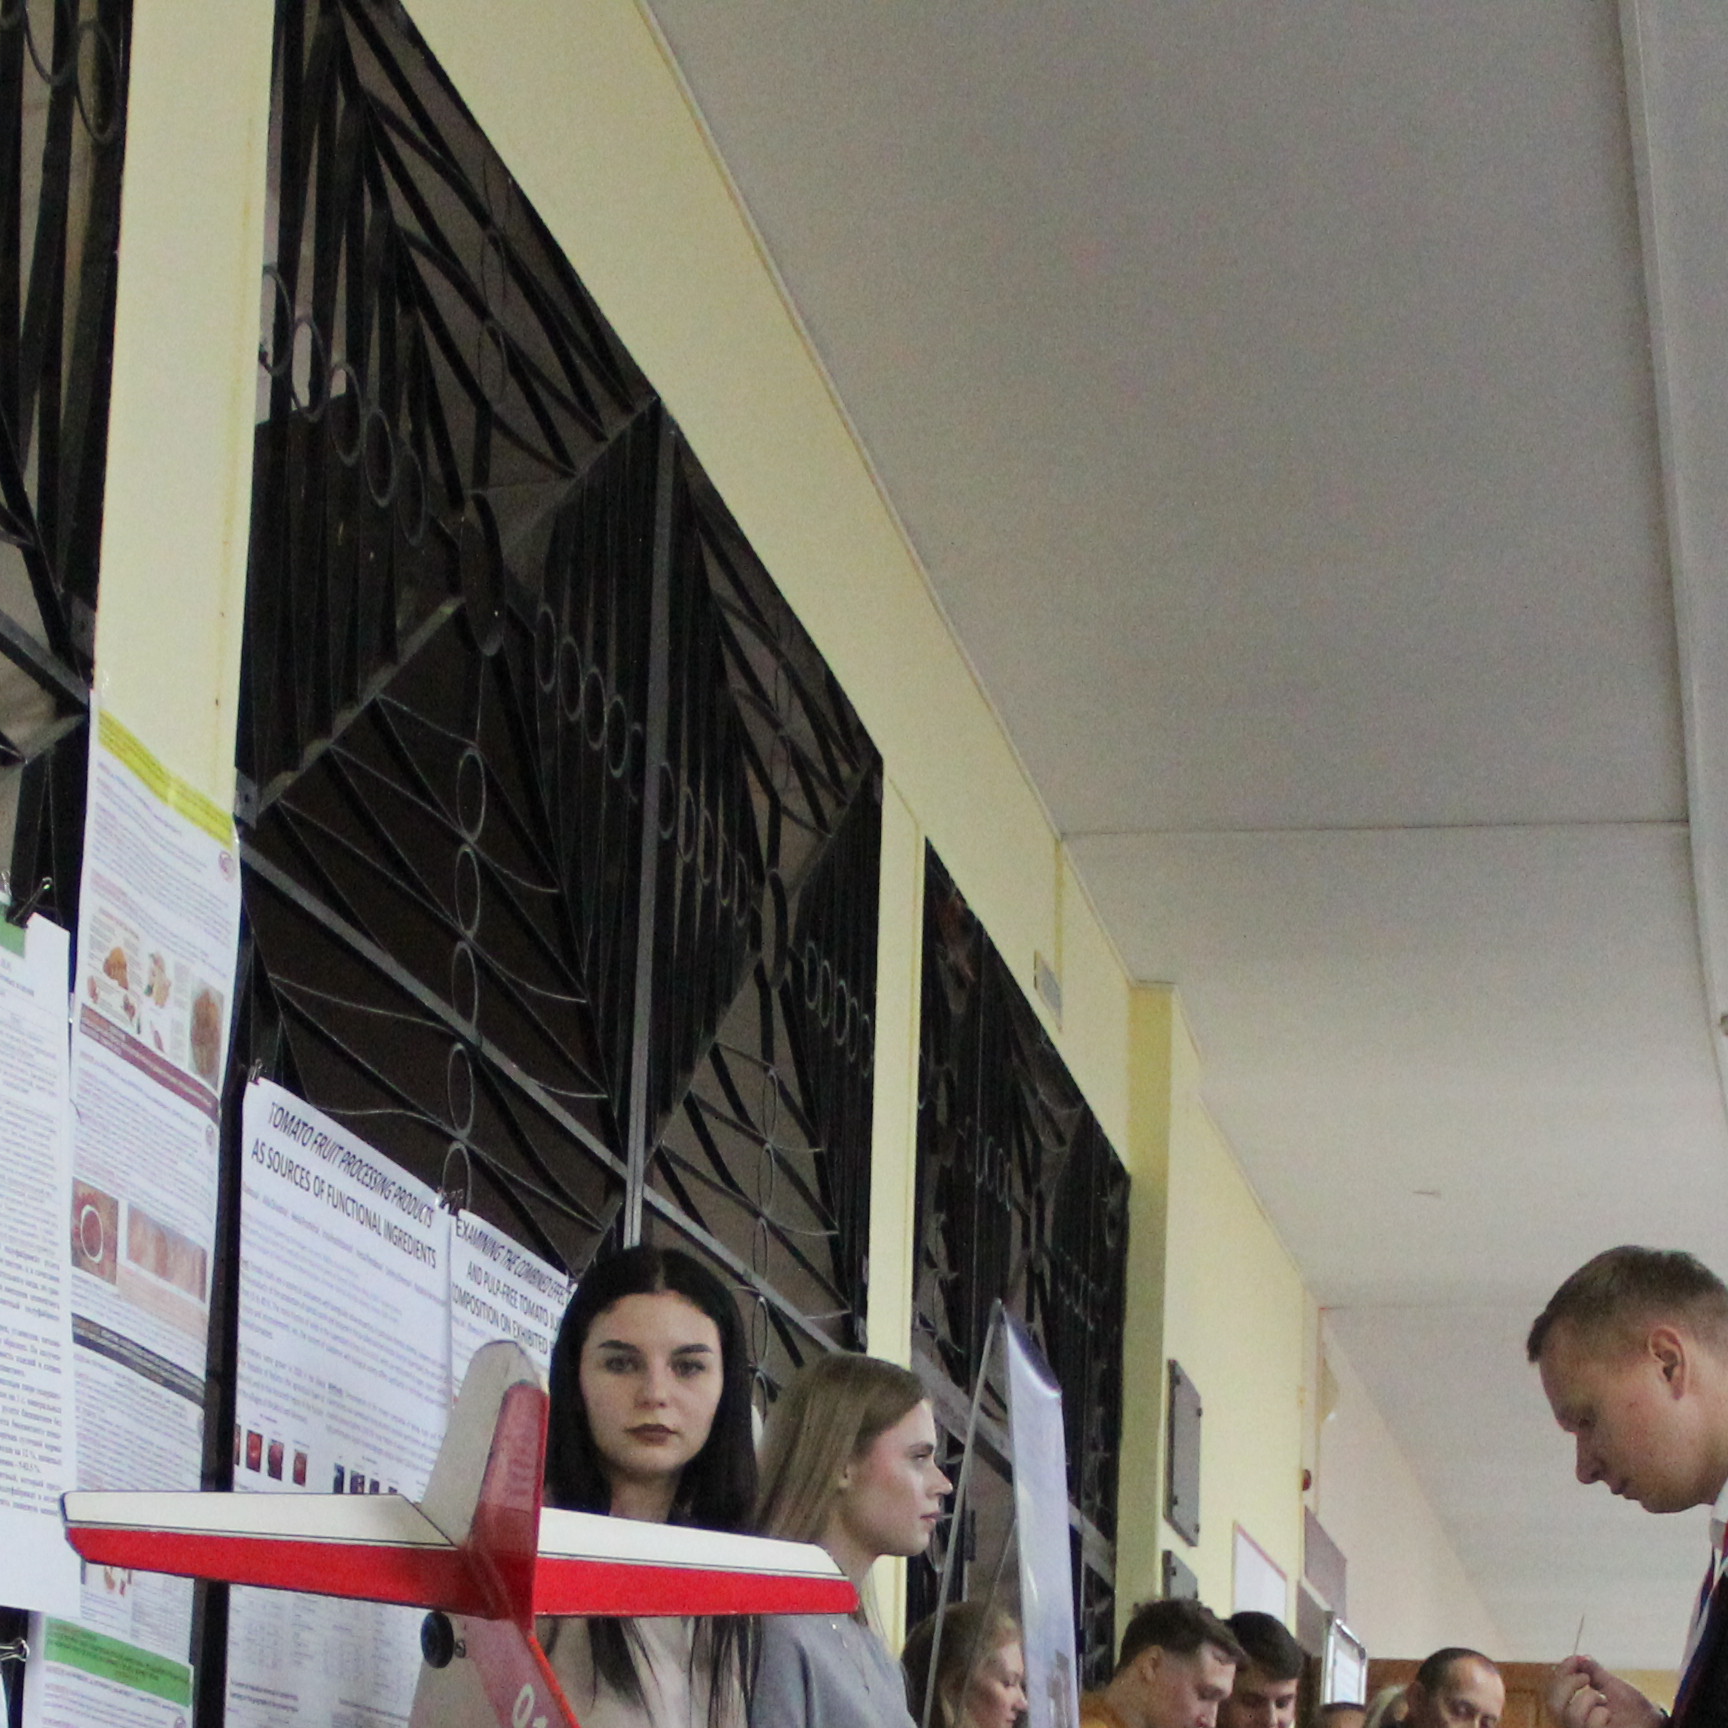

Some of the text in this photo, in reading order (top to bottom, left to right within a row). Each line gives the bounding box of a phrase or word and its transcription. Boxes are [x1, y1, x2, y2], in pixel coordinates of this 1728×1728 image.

[268, 1102, 434, 1229] TOMATO FRUIT PROCESSING PRODUCTS
[251, 1138, 437, 1269] AS SOURCES OF FUNCTIONAL INGREDIENTS
[455, 1216, 502, 1266] EXAMINING
[500, 1247, 521, 1272] THE
[466, 1261, 485, 1287] AND
[483, 1267, 520, 1310] PULP-FREE
[519, 1294, 549, 1328] TOMATO
[500, 1312, 512, 1335] ON
[511, 1318, 548, 1355] EXHIBITED
